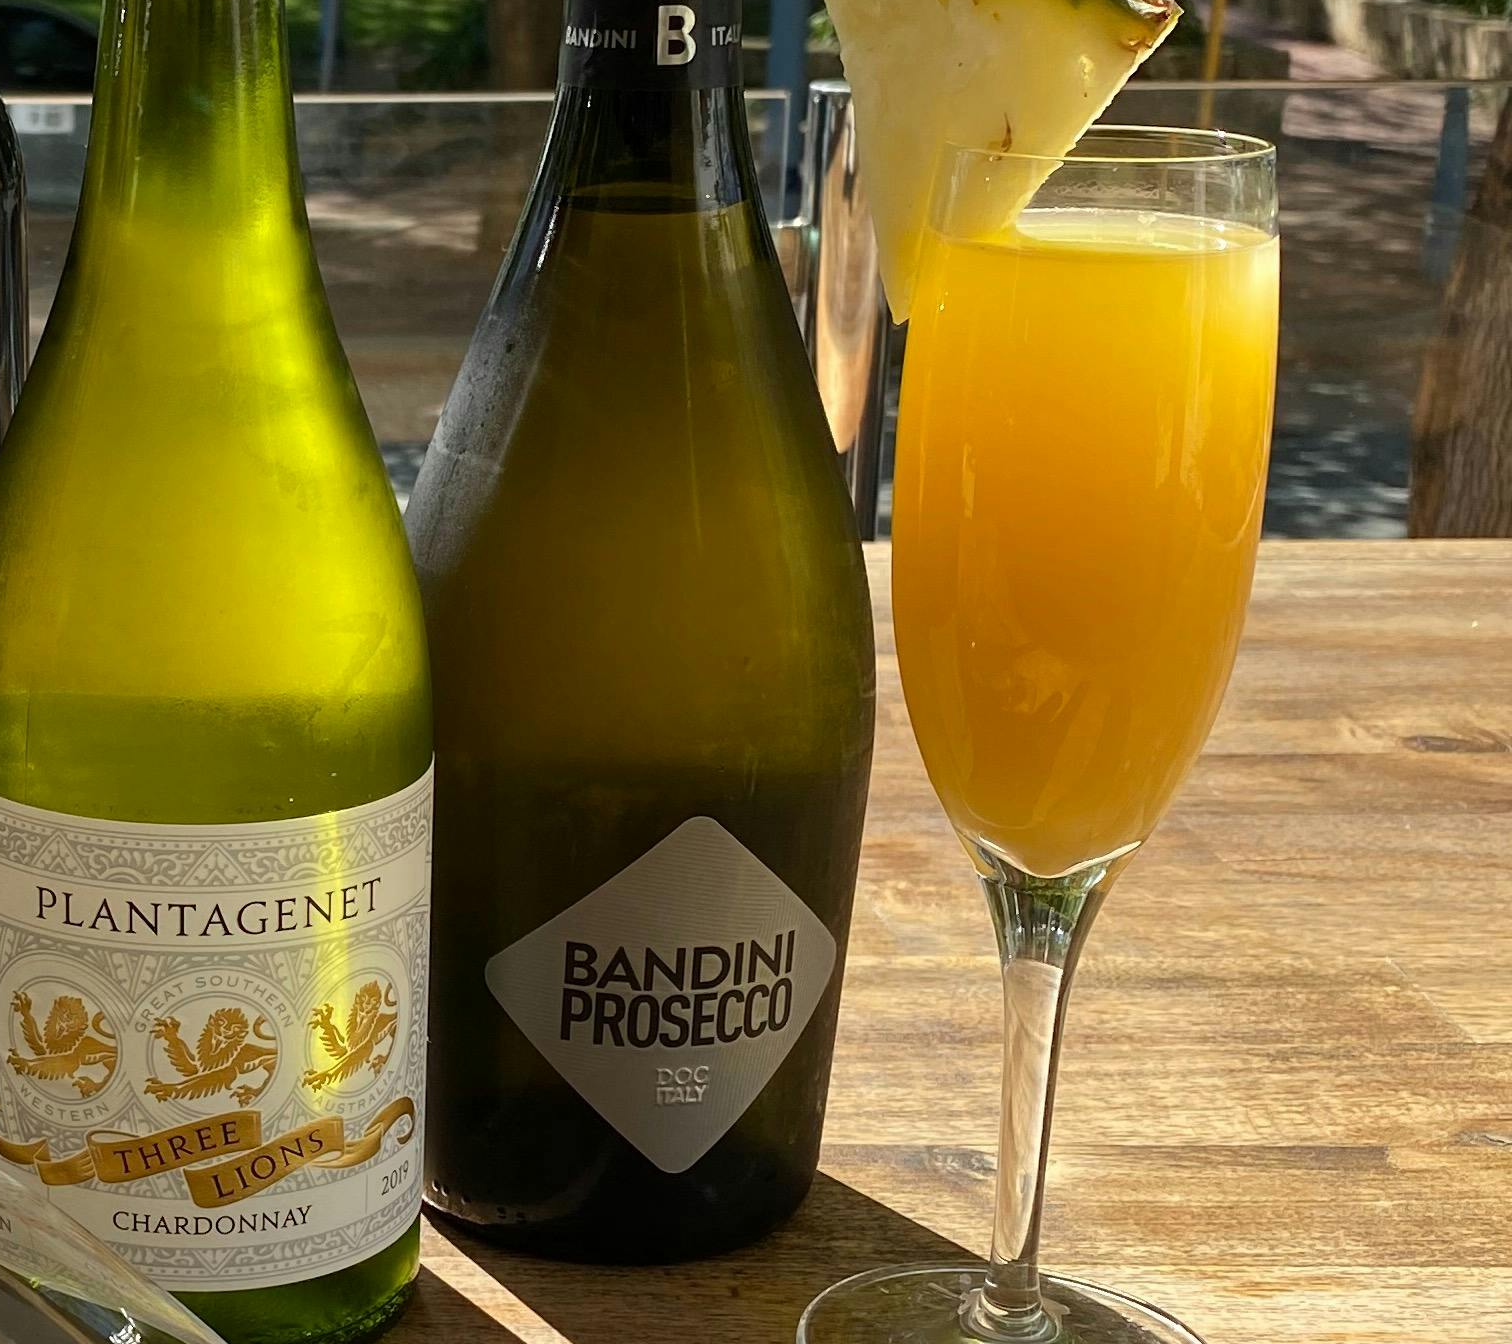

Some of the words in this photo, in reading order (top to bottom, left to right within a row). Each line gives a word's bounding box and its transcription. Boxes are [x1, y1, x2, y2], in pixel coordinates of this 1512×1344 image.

[565, 24, 638, 49] BANDINI
[656, 4, 697, 66] B
[34, 876, 383, 937] PLANTAGENET
[563, 929, 796, 992] BANDINI
[134, 981, 185, 1034] GREAT
[194, 974, 294, 1029] SOUTHERN
[559, 977, 794, 1049] PROSECCO
[18, 1082, 110, 1122] WESTERN
[314, 1068, 396, 1115] AUSTRALIA
[655, 1064, 710, 1086] DOC
[655, 1084, 709, 1106] ITALY
[112, 1118, 242, 1176] THREE
[211, 1126, 325, 1199] LIONS
[112, 1204, 314, 1237] CHARDONNAY
[380, 1159, 410, 1197] 2019
